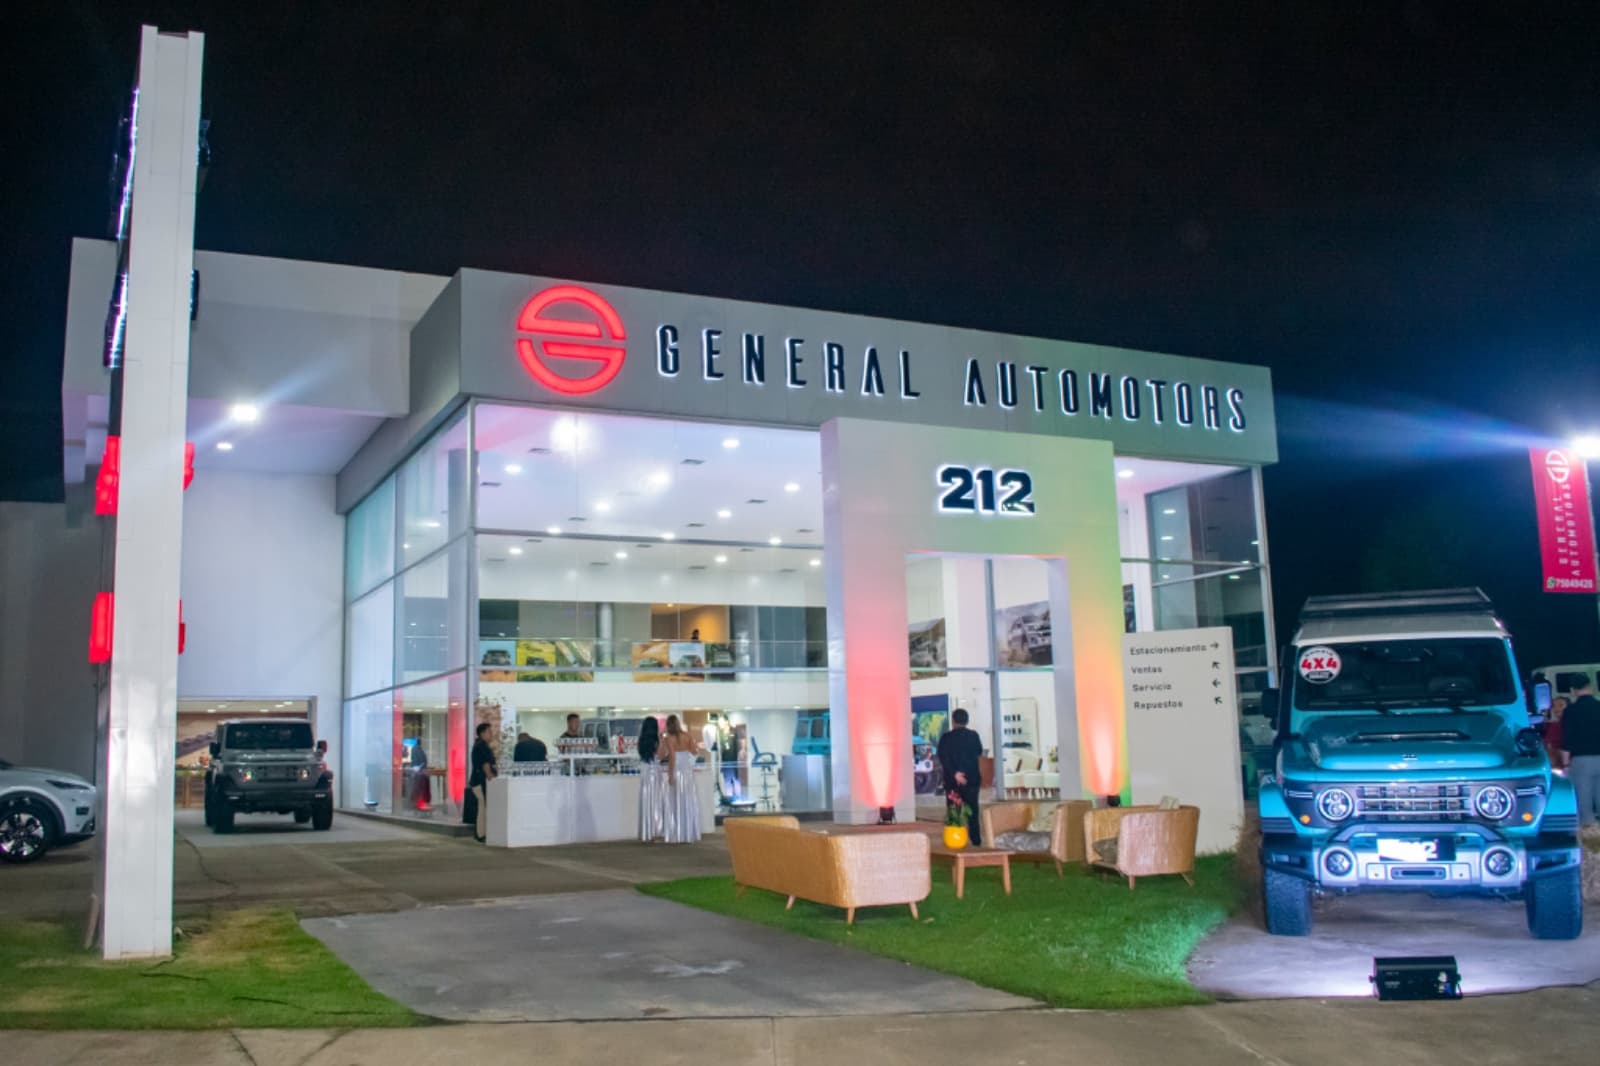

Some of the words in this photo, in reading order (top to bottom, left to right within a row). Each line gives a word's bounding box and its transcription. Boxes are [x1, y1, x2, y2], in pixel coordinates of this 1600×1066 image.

[655, 323, 920, 400] GENERAL
[963, 357, 1248, 433] AUTOMOTORS
[936, 464, 1036, 516] 212
[1552, 497, 1569, 565] GENERAL
[1561, 484, 1581, 577] AUTOMOTORS
[1129, 643, 1208, 656] Estacionamiento
[1131, 665, 1163, 674] Ventas
[1132, 683, 1172, 693] Servicio
[1133, 700, 1184, 711] Repuestos
